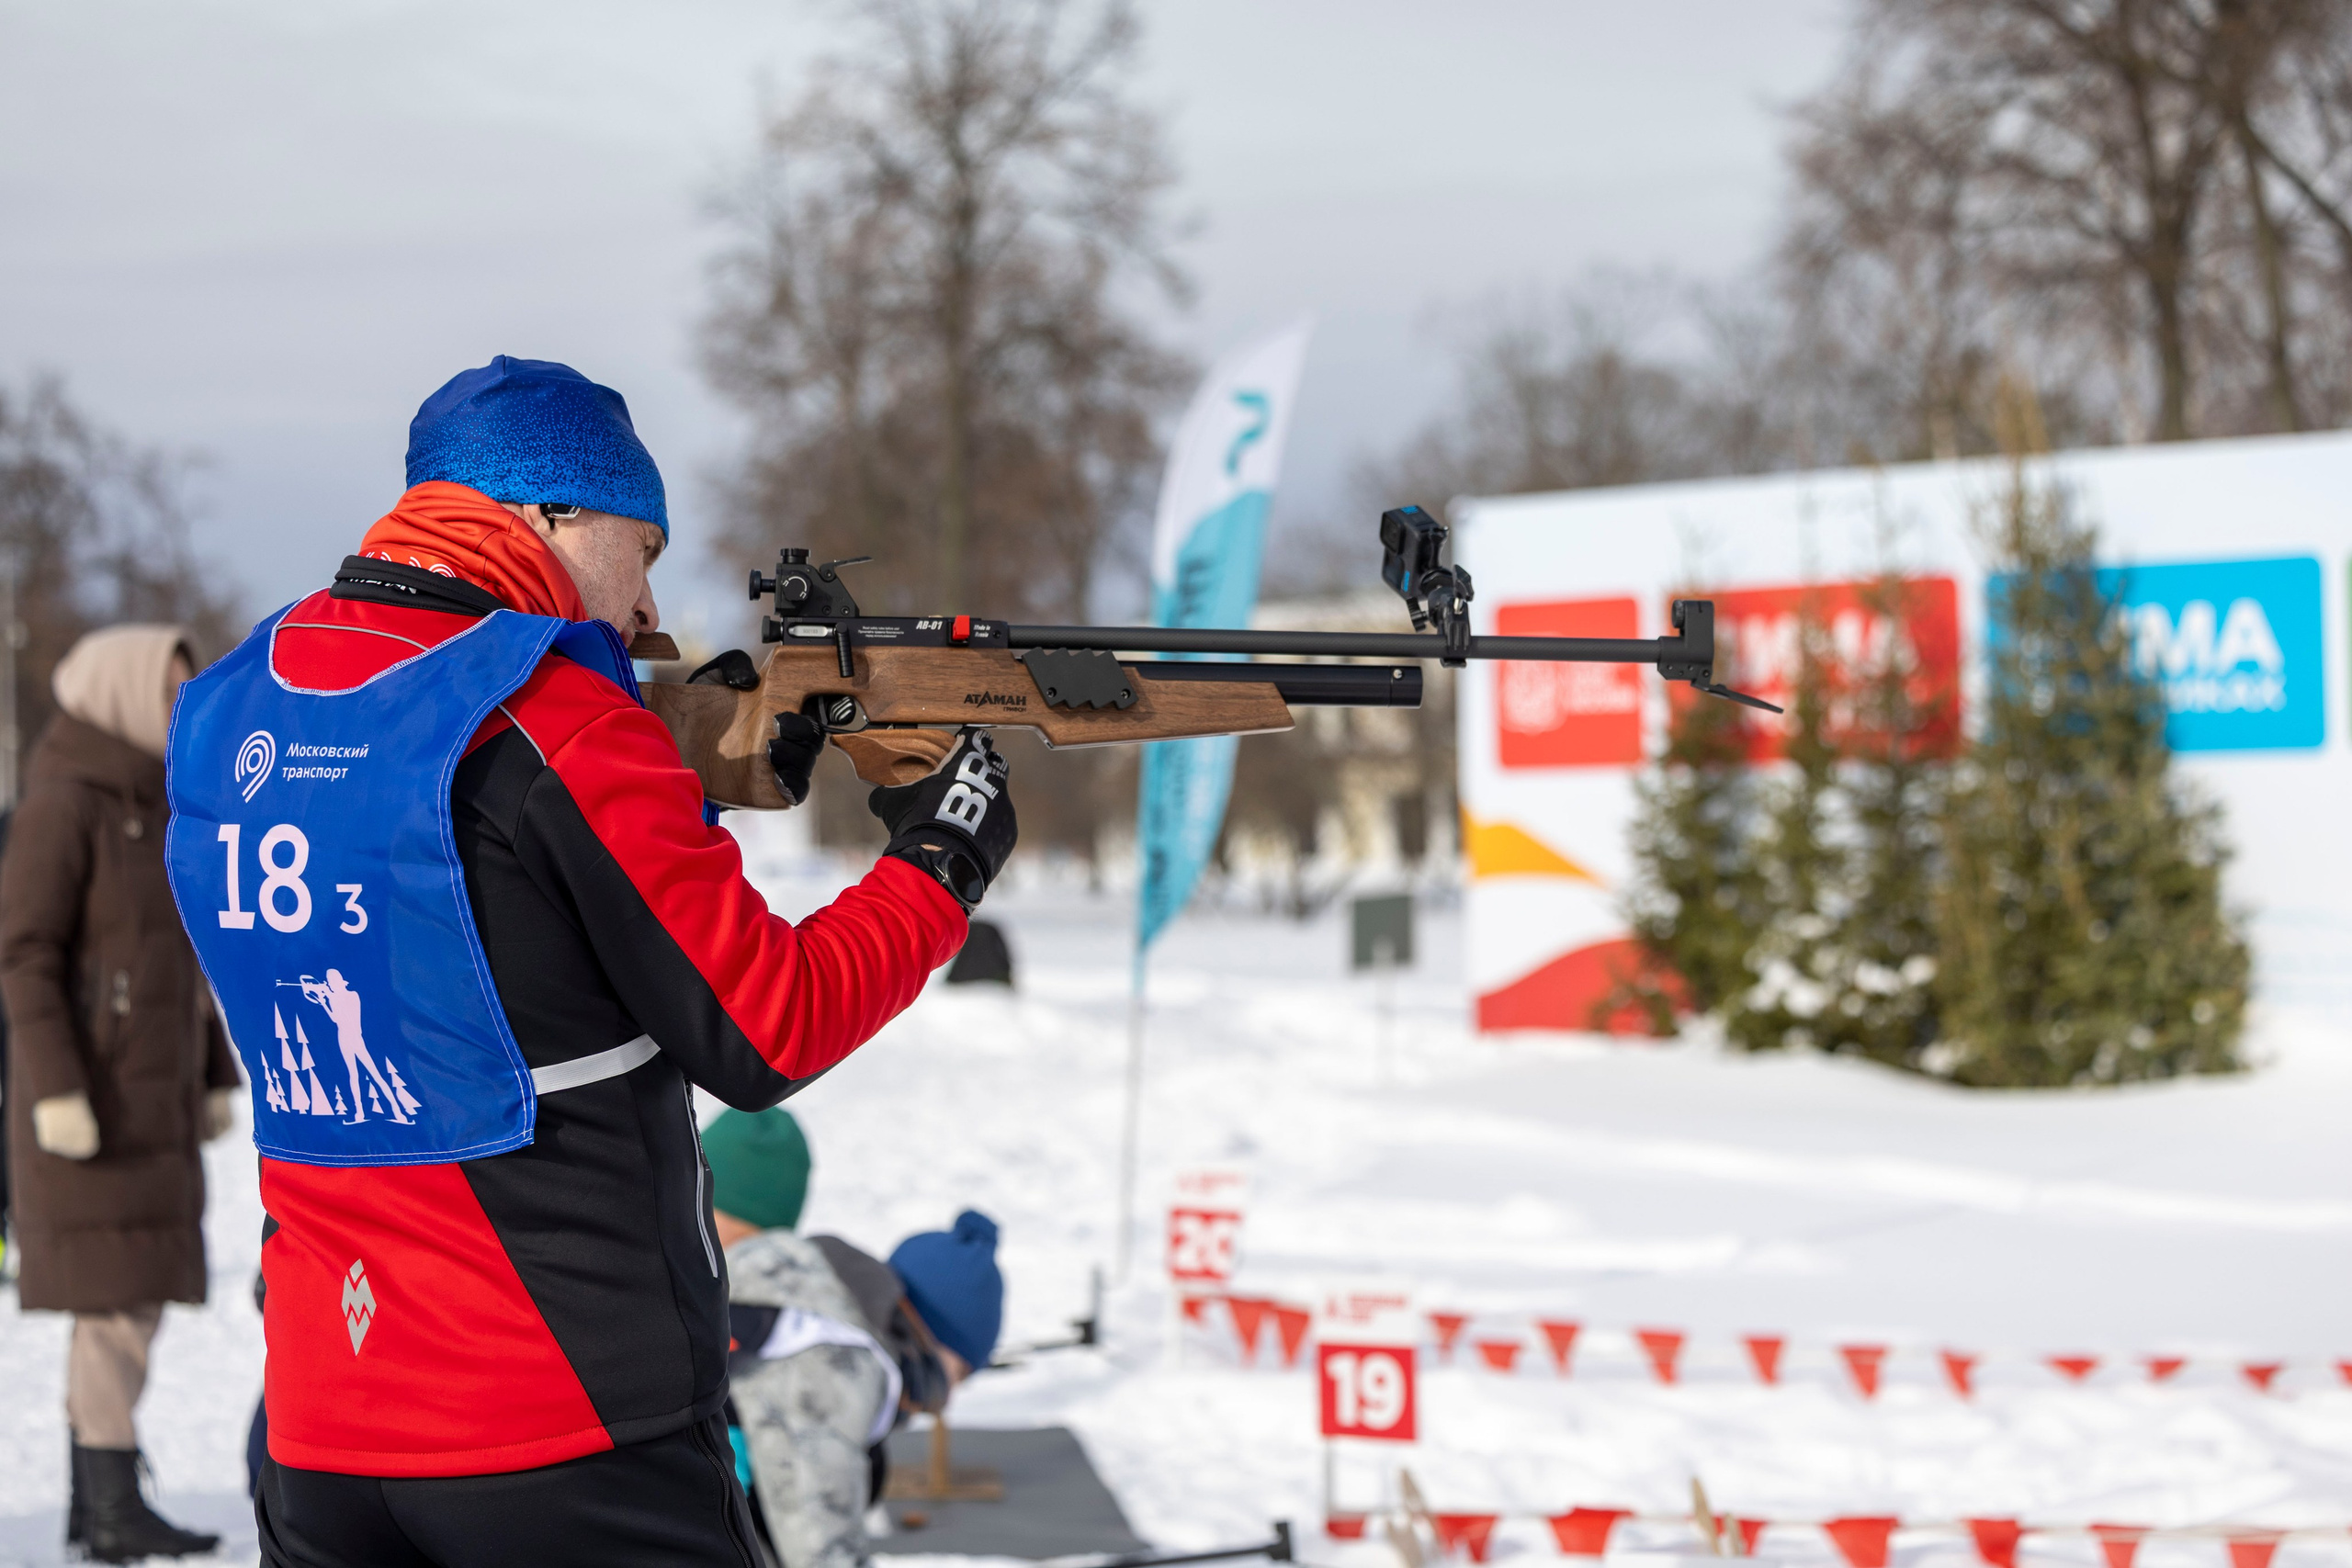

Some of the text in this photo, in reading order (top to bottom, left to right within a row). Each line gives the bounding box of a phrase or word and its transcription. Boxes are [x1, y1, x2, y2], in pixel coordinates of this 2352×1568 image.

[964, 691, 1027, 708] АТАМАН
[285, 741, 369, 760] Московский
[281, 764, 349, 781] транспорт
[217, 823, 369, 935] 18 3
[1324, 1350, 1408, 1432] 19
